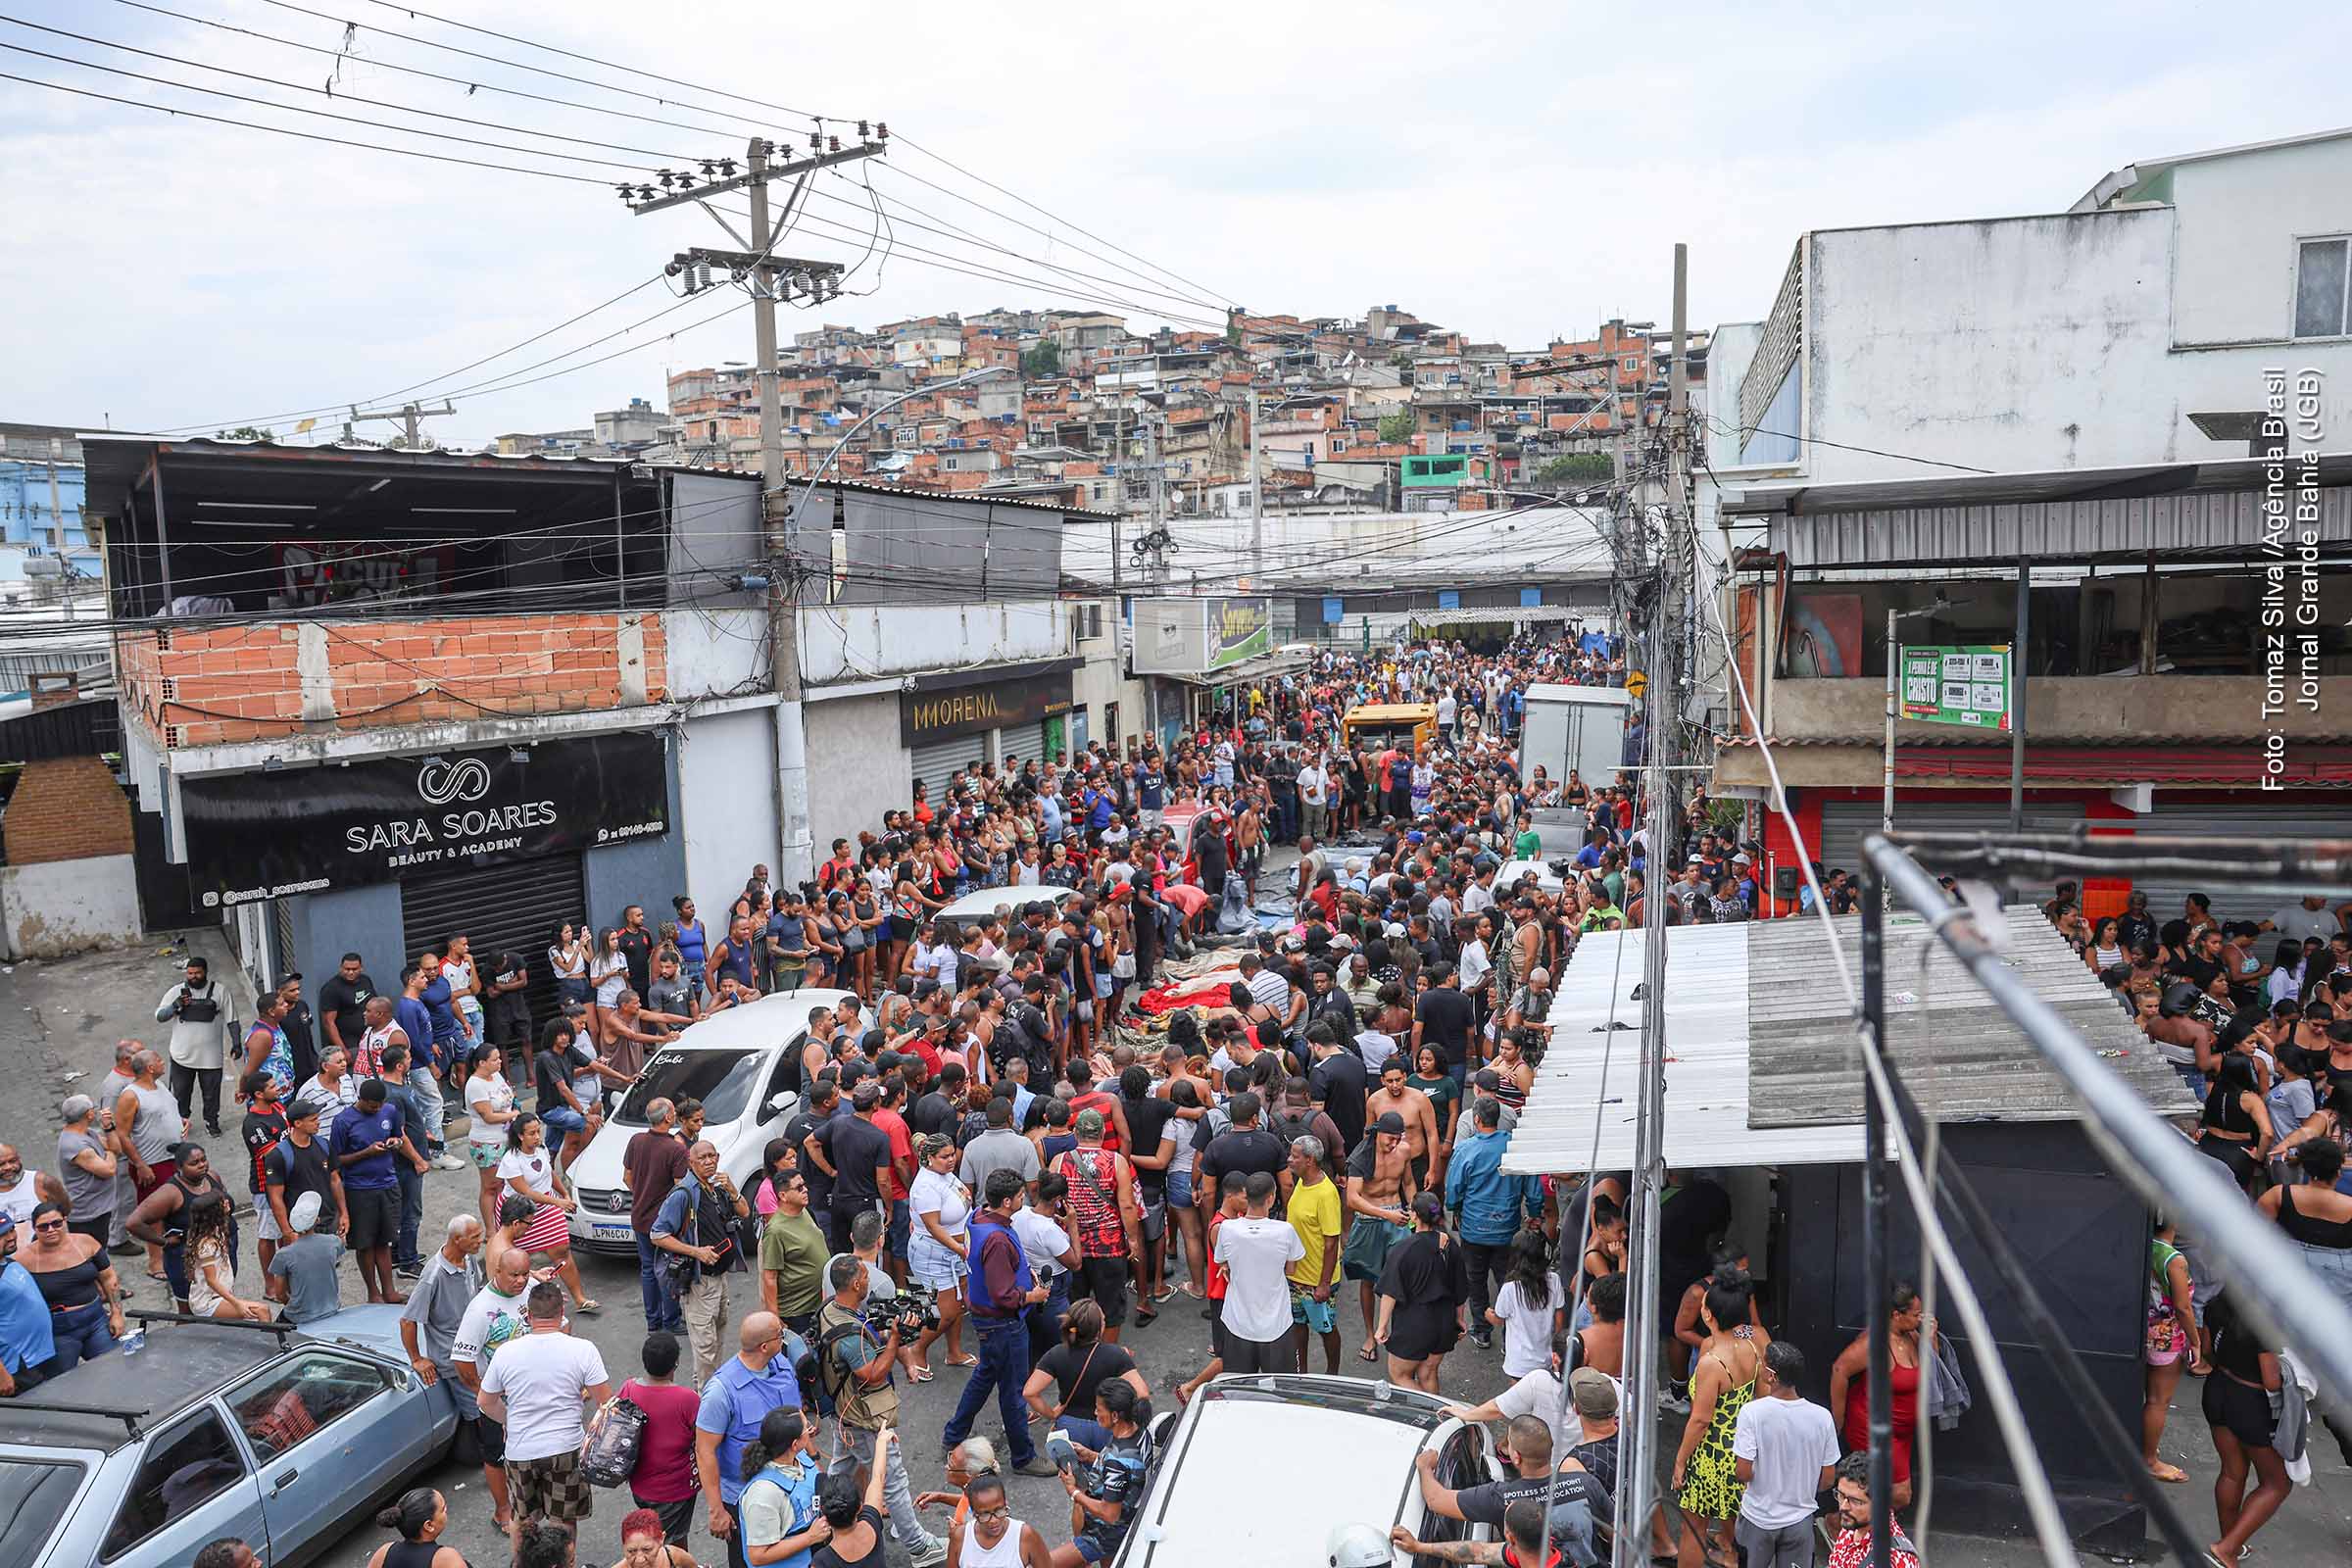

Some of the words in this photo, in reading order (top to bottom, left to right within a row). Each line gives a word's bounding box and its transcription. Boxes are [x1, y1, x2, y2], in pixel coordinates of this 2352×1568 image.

[1907, 676, 1936, 703] CRISTO
[346, 819, 433, 854] SARA
[443, 800, 557, 839] SOARES
[388, 847, 442, 868] BEAUTY
[447, 847, 456, 858] &
[460, 837, 522, 857] ACADEMY
[1503, 1488, 1539, 1499] SPOTLESS
